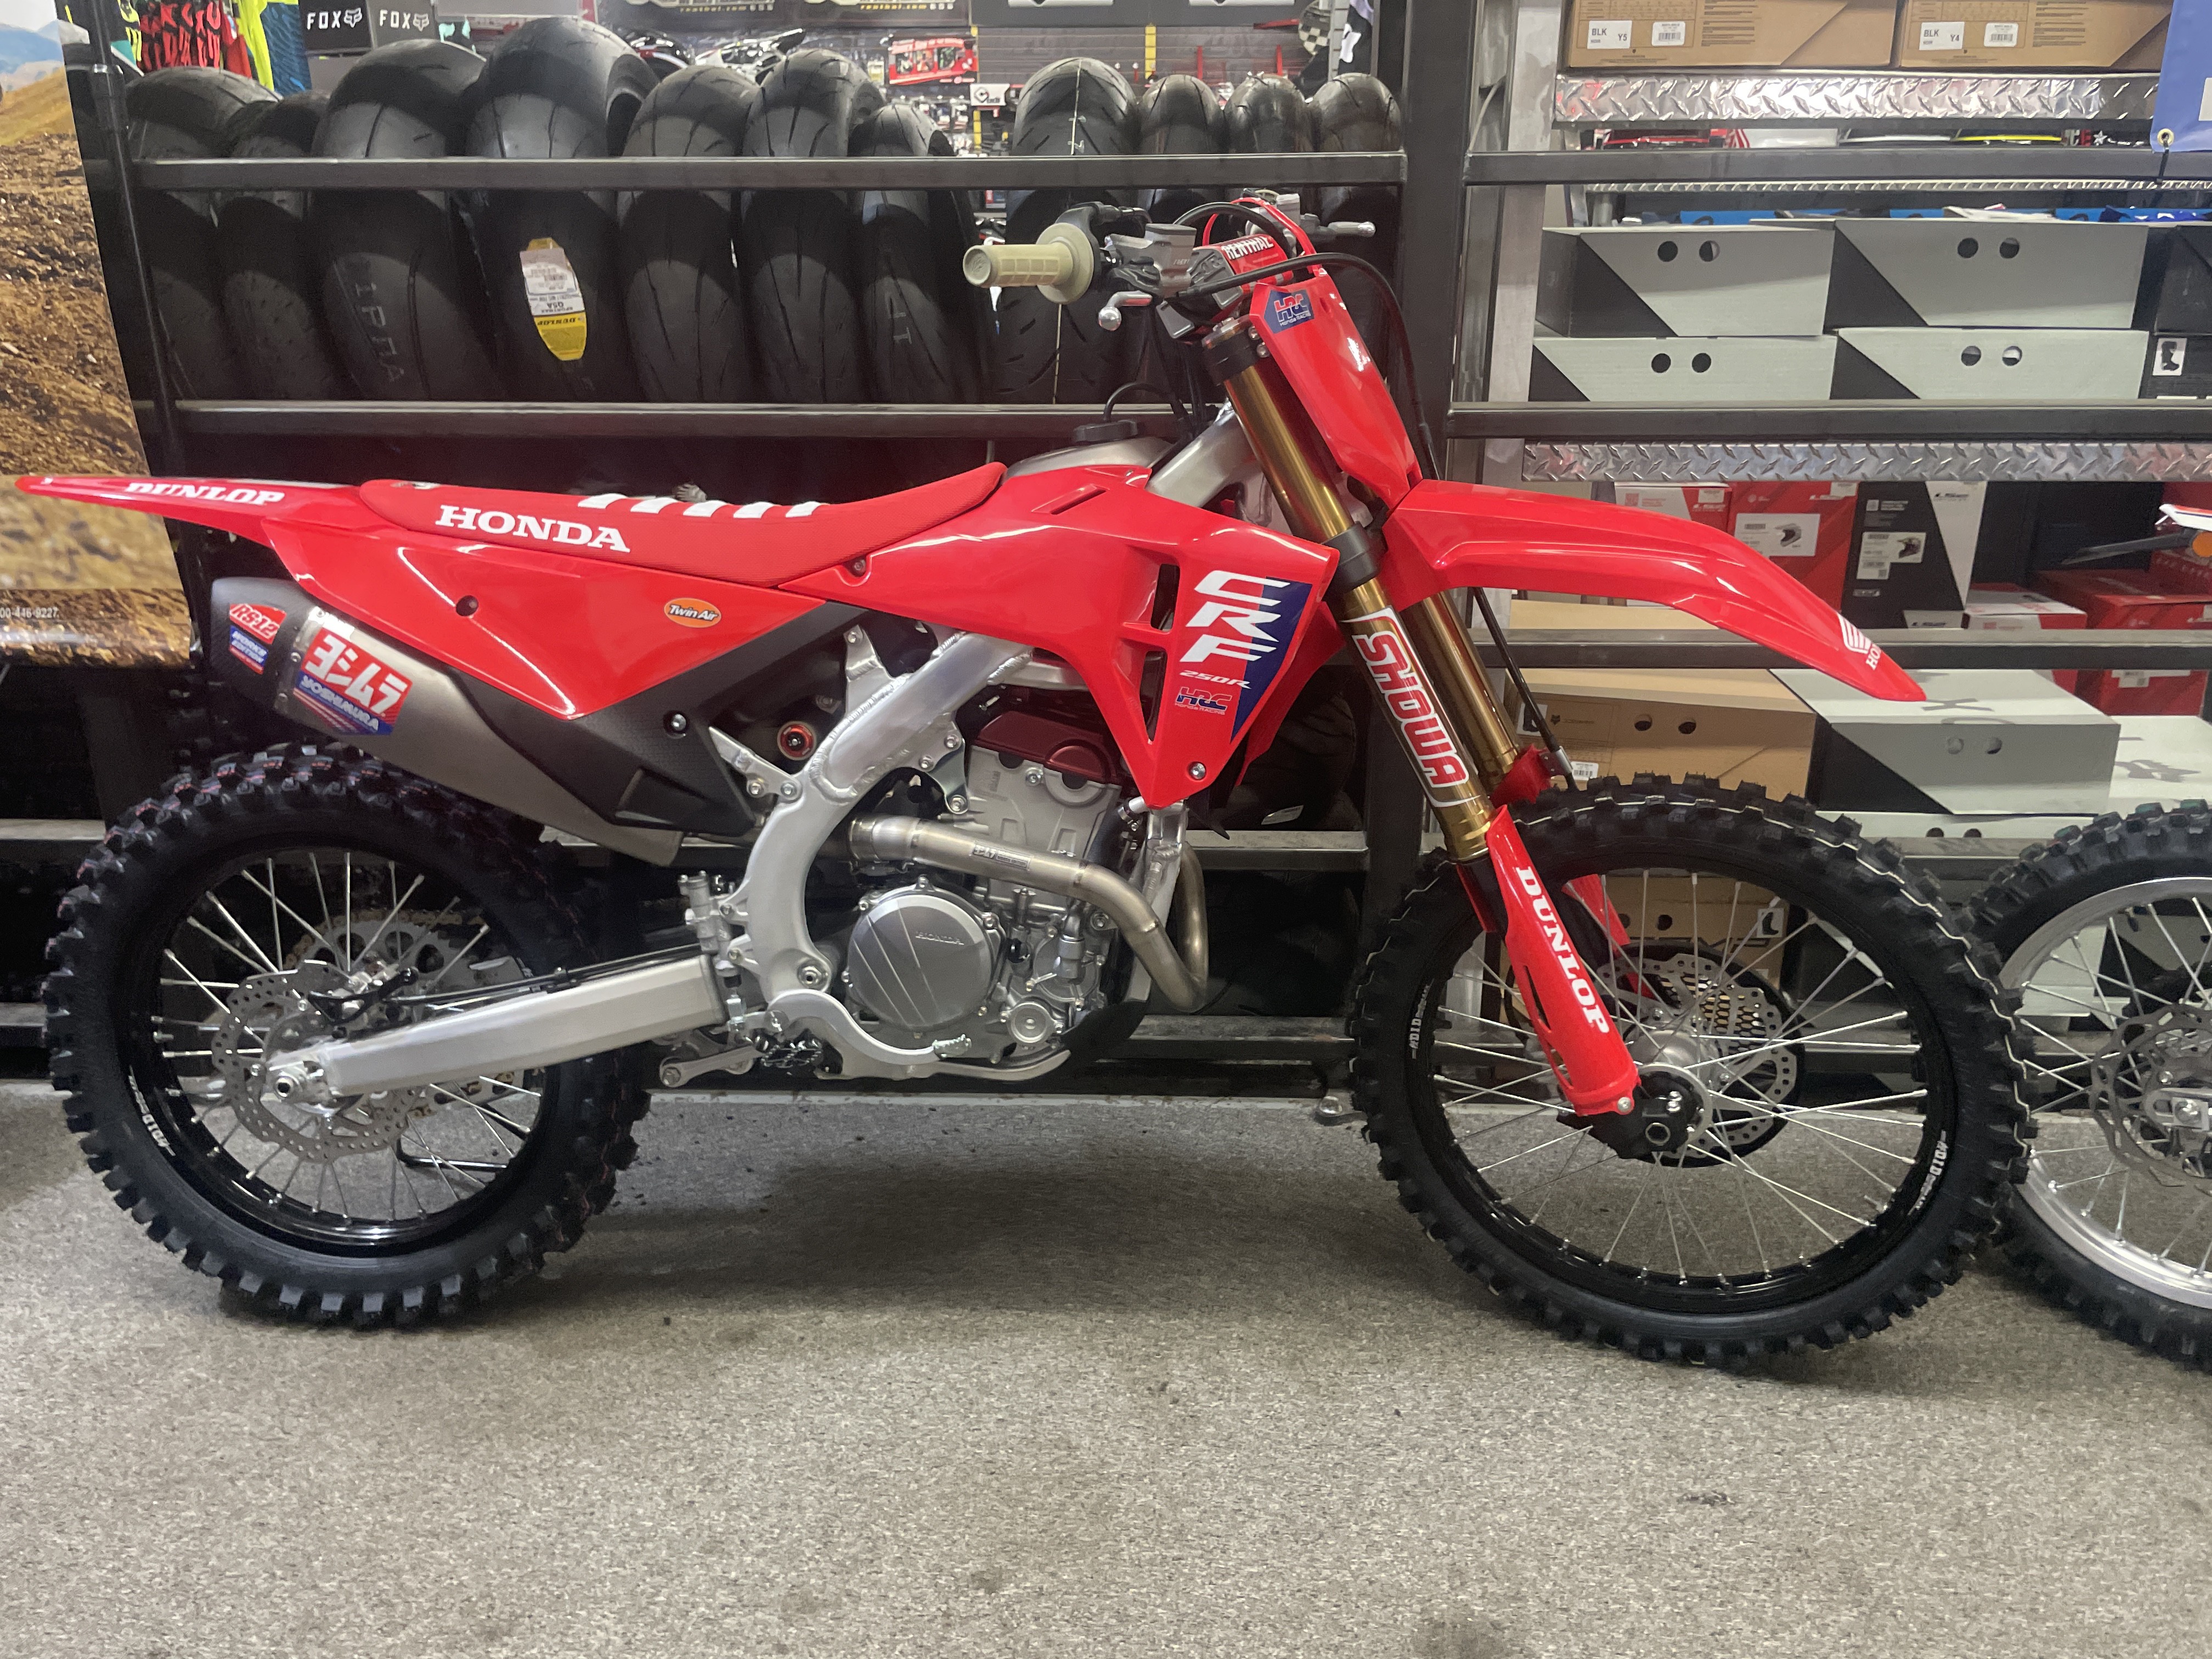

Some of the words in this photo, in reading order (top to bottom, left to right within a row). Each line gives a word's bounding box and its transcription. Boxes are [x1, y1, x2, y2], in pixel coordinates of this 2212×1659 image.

[307, 10, 341, 30] FOX
[380, 9, 411, 29] FOX
[1592, 28, 1607, 36] BLK
[1923, 29, 1939, 37] BLK
[1221, 236, 1274, 260] RENTHAL
[537, 317, 576, 326] DUNLOP
[126, 482, 285, 505] DUNLOP
[435, 504, 630, 553] HONDA
[669, 604, 698, 618] Twin
[697, 610, 718, 620] Air
[1180, 570, 1290, 662] CRF
[304, 634, 408, 714] ヨシムラ
[1179, 669, 1252, 690] 250R
[300, 674, 379, 731] YOSHIMURA
[1176, 686, 1233, 711] HRC
[1351, 630, 1470, 788] SHOWA
[1199, 706, 1226, 715] RACING
[1516, 866, 1610, 1034] DUNLOP
